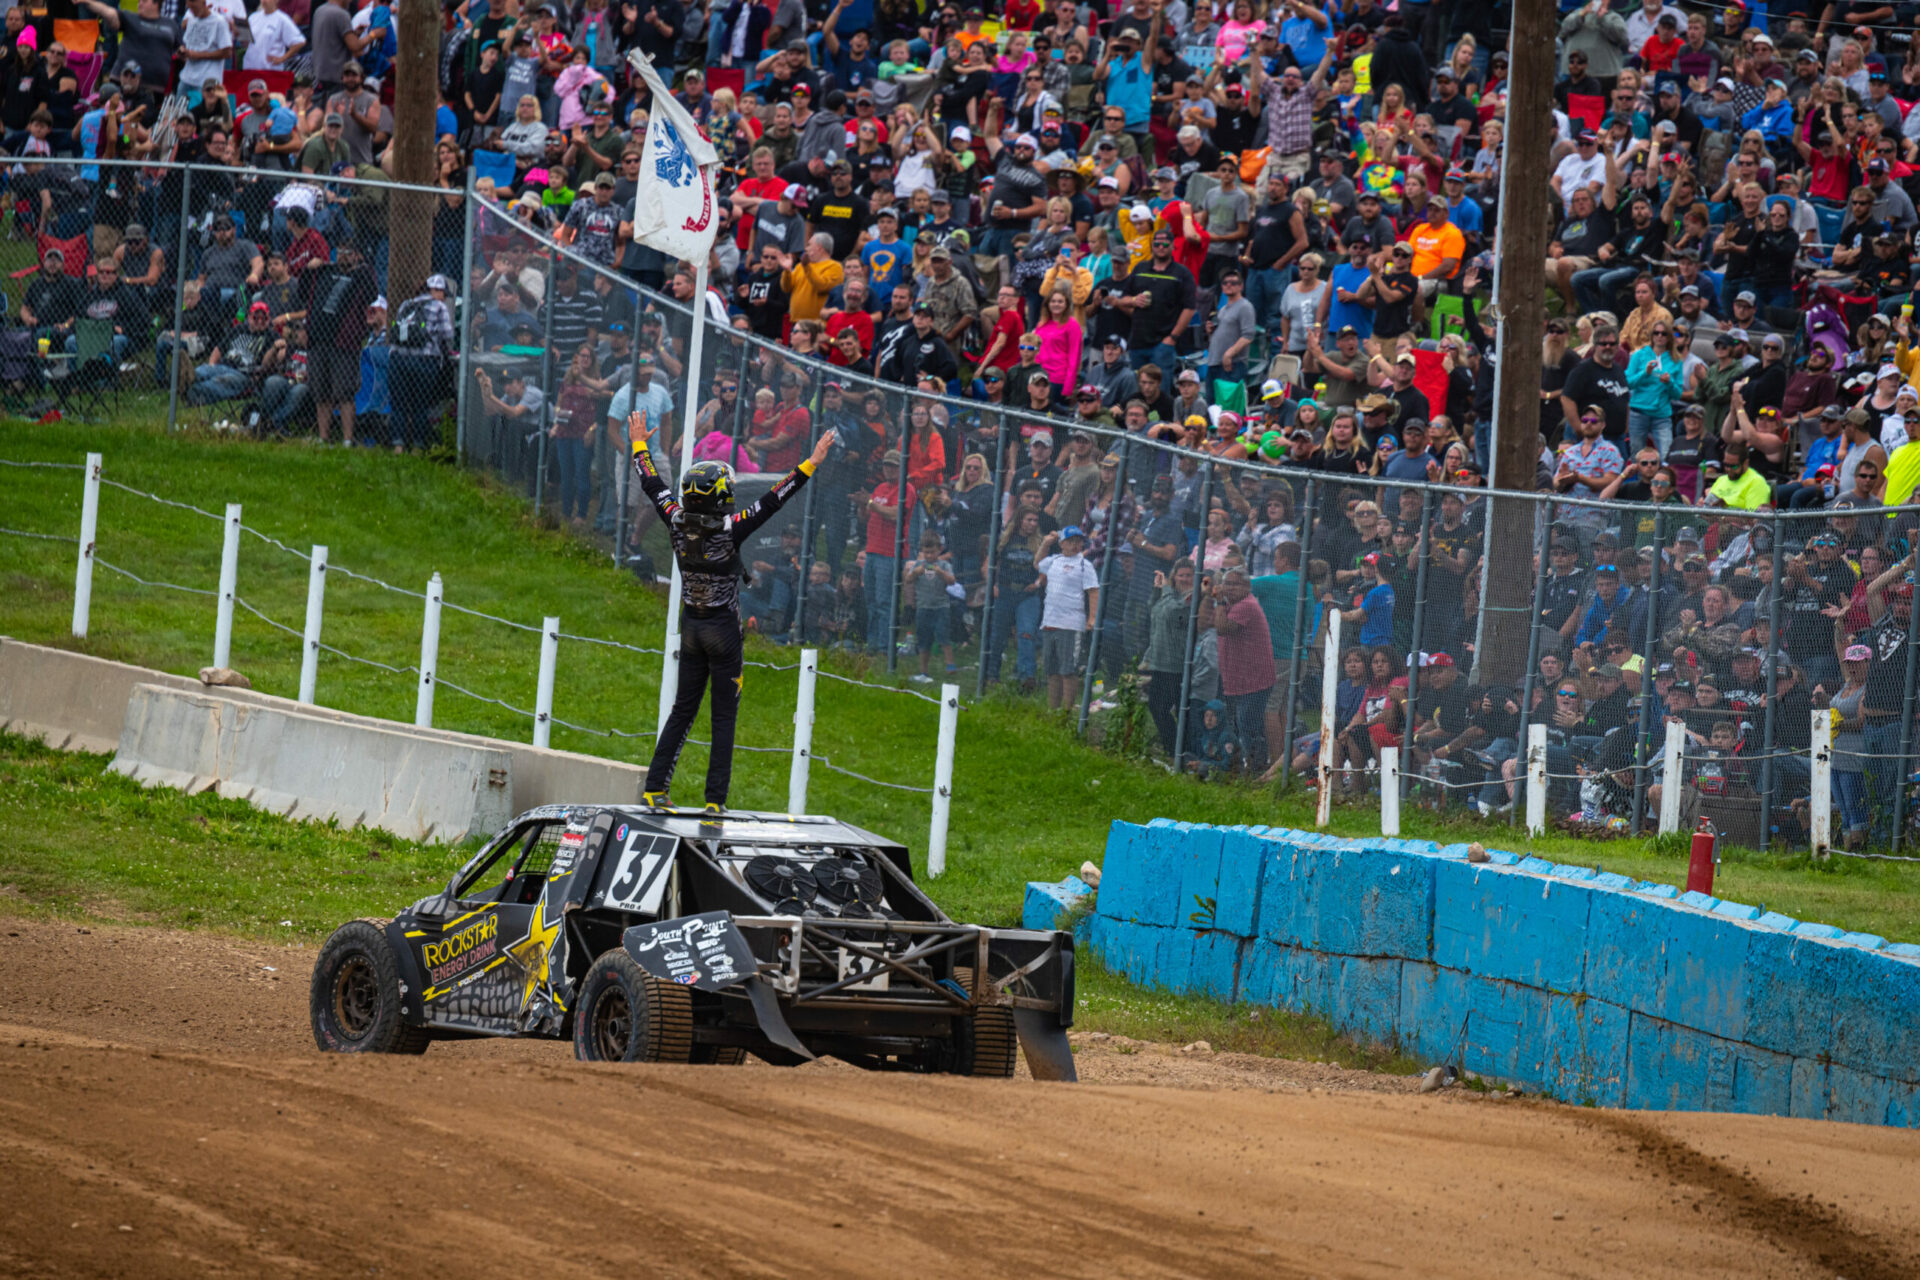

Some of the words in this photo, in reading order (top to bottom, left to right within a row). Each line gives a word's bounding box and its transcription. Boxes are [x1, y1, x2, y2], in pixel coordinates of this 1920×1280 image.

[612, 833, 678, 903] 37
[620, 902, 635, 910] PRO
[432, 953, 468, 983] ENERGY
[470, 940, 497, 965] DRINK
